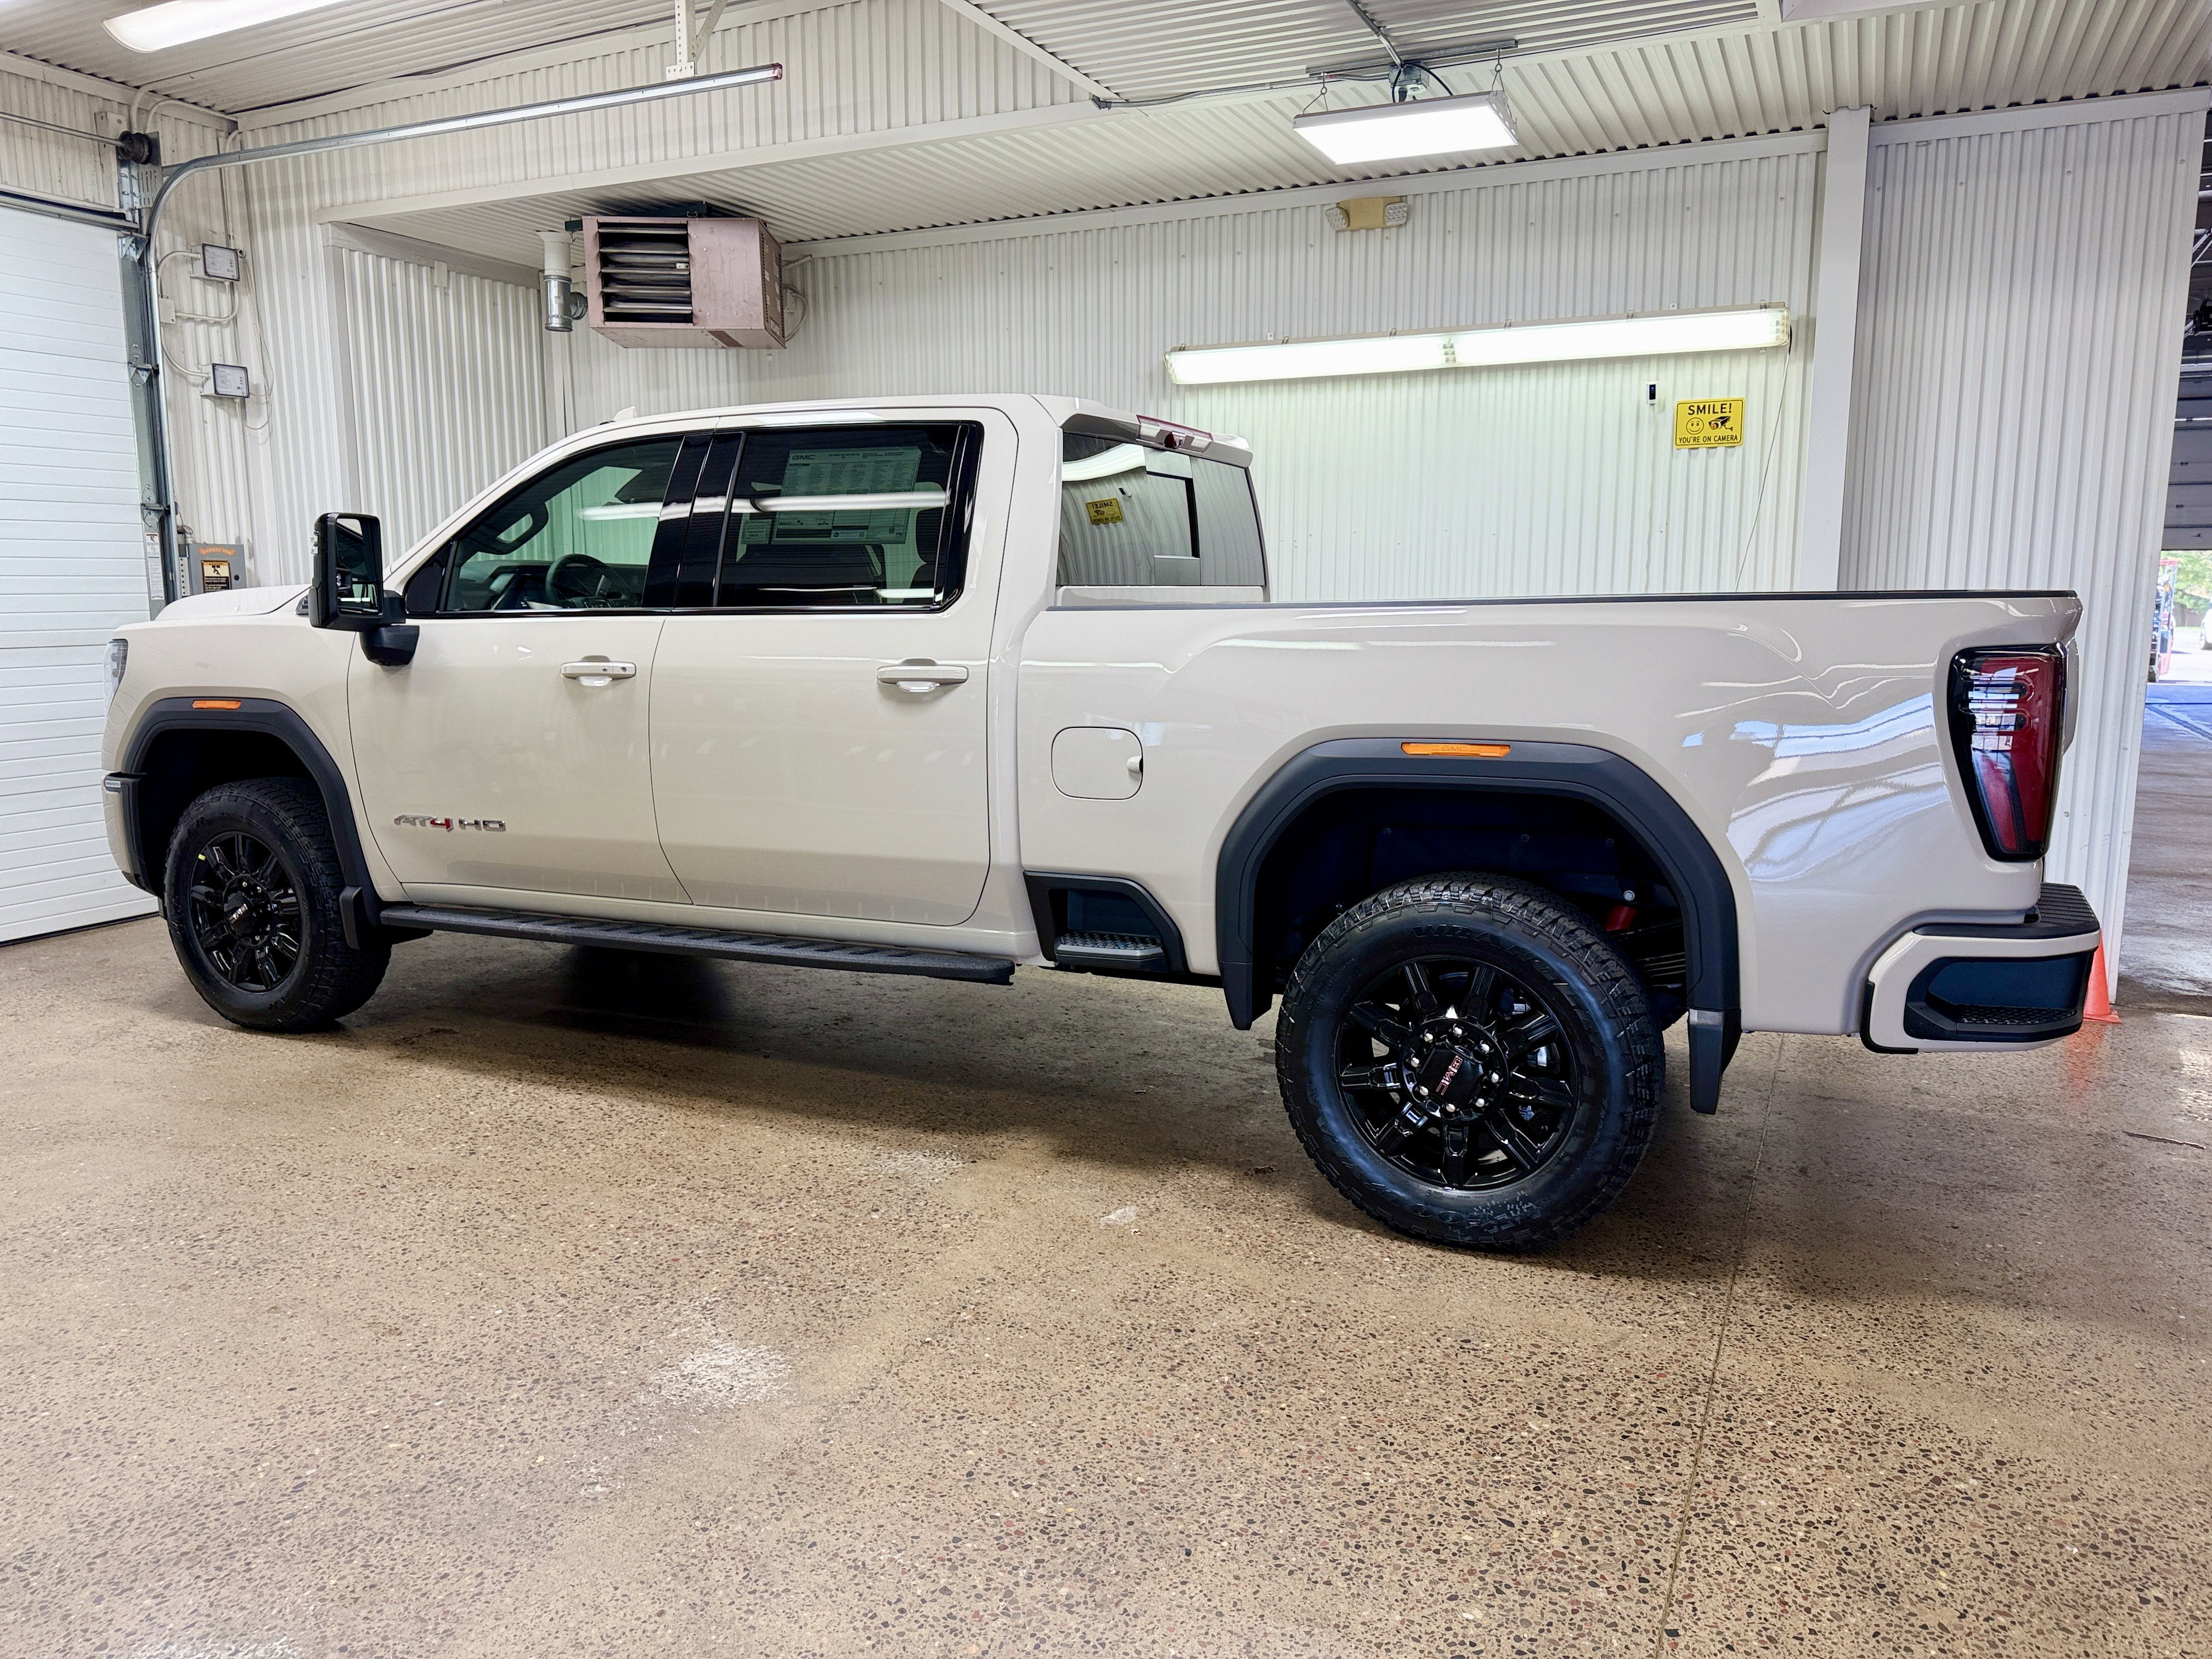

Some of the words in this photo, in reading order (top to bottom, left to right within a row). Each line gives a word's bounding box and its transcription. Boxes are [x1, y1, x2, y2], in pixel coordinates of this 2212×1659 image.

[1688, 403, 1732, 415] SMILE!
[1679, 436, 1700, 444] YOU'RE
[1714, 434, 1738, 442] CAMERA
[394, 814, 454, 832] AT4
[458, 816, 506, 832] HD
[1412, 924, 1606, 1059] WRANGLER
[1436, 1055, 1463, 1096] GMC
